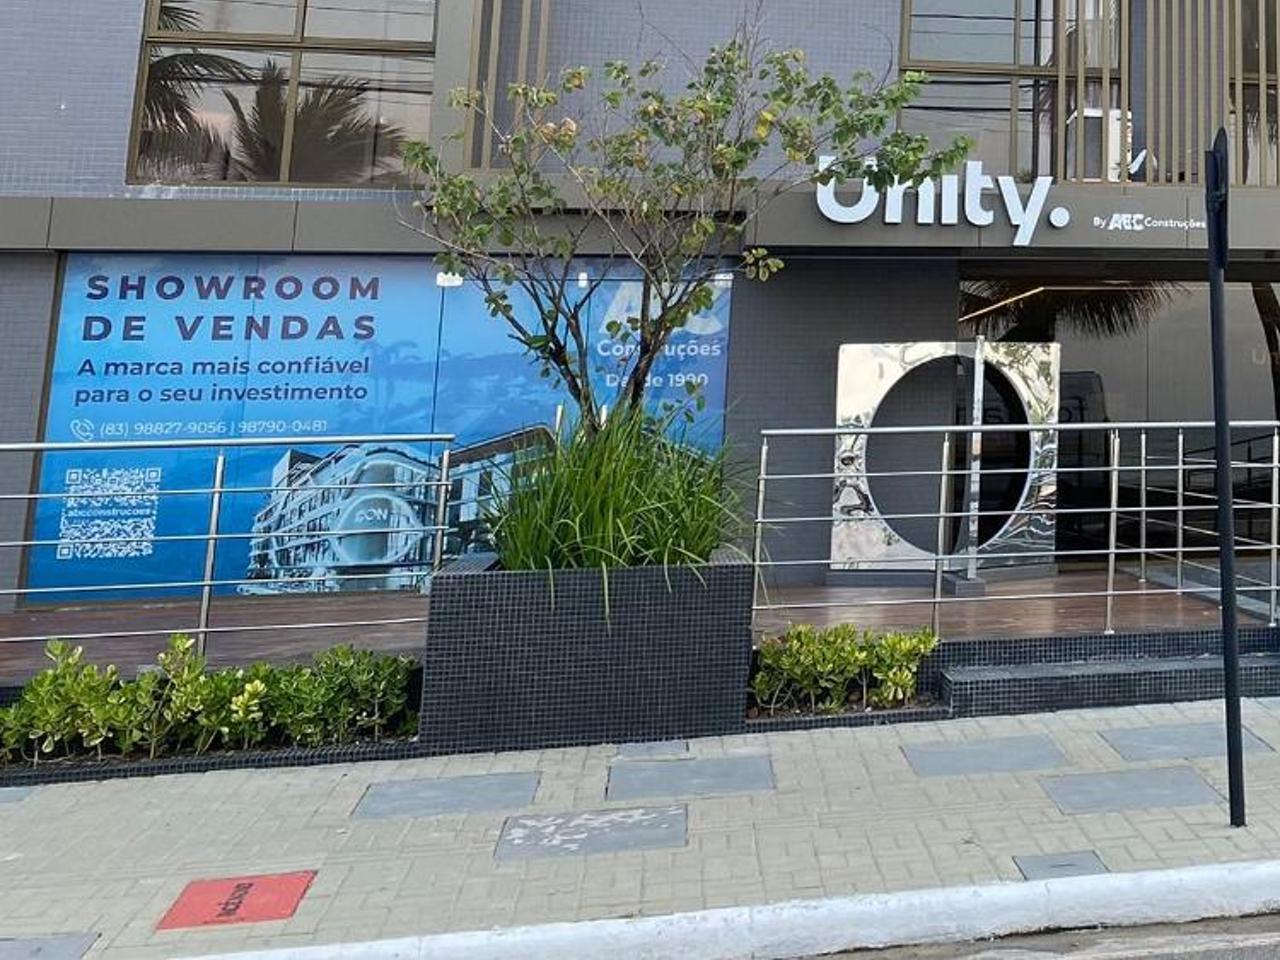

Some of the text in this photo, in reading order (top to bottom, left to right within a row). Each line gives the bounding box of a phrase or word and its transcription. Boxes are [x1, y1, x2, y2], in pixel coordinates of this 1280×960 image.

[816, 155, 1071, 247] Unity.
[1093, 216, 1107, 229] By
[85, 275, 380, 301] SHOWROOM
[82, 315, 376, 341] DE VENDAS
[597, 340, 721, 361] Conuções
[77, 356, 370, 376] A marca mais confiável
[74, 383, 369, 407] para o seu investimento
[100, 422, 130, 437] (83)
[133, 420, 227, 435] 98827-9056
